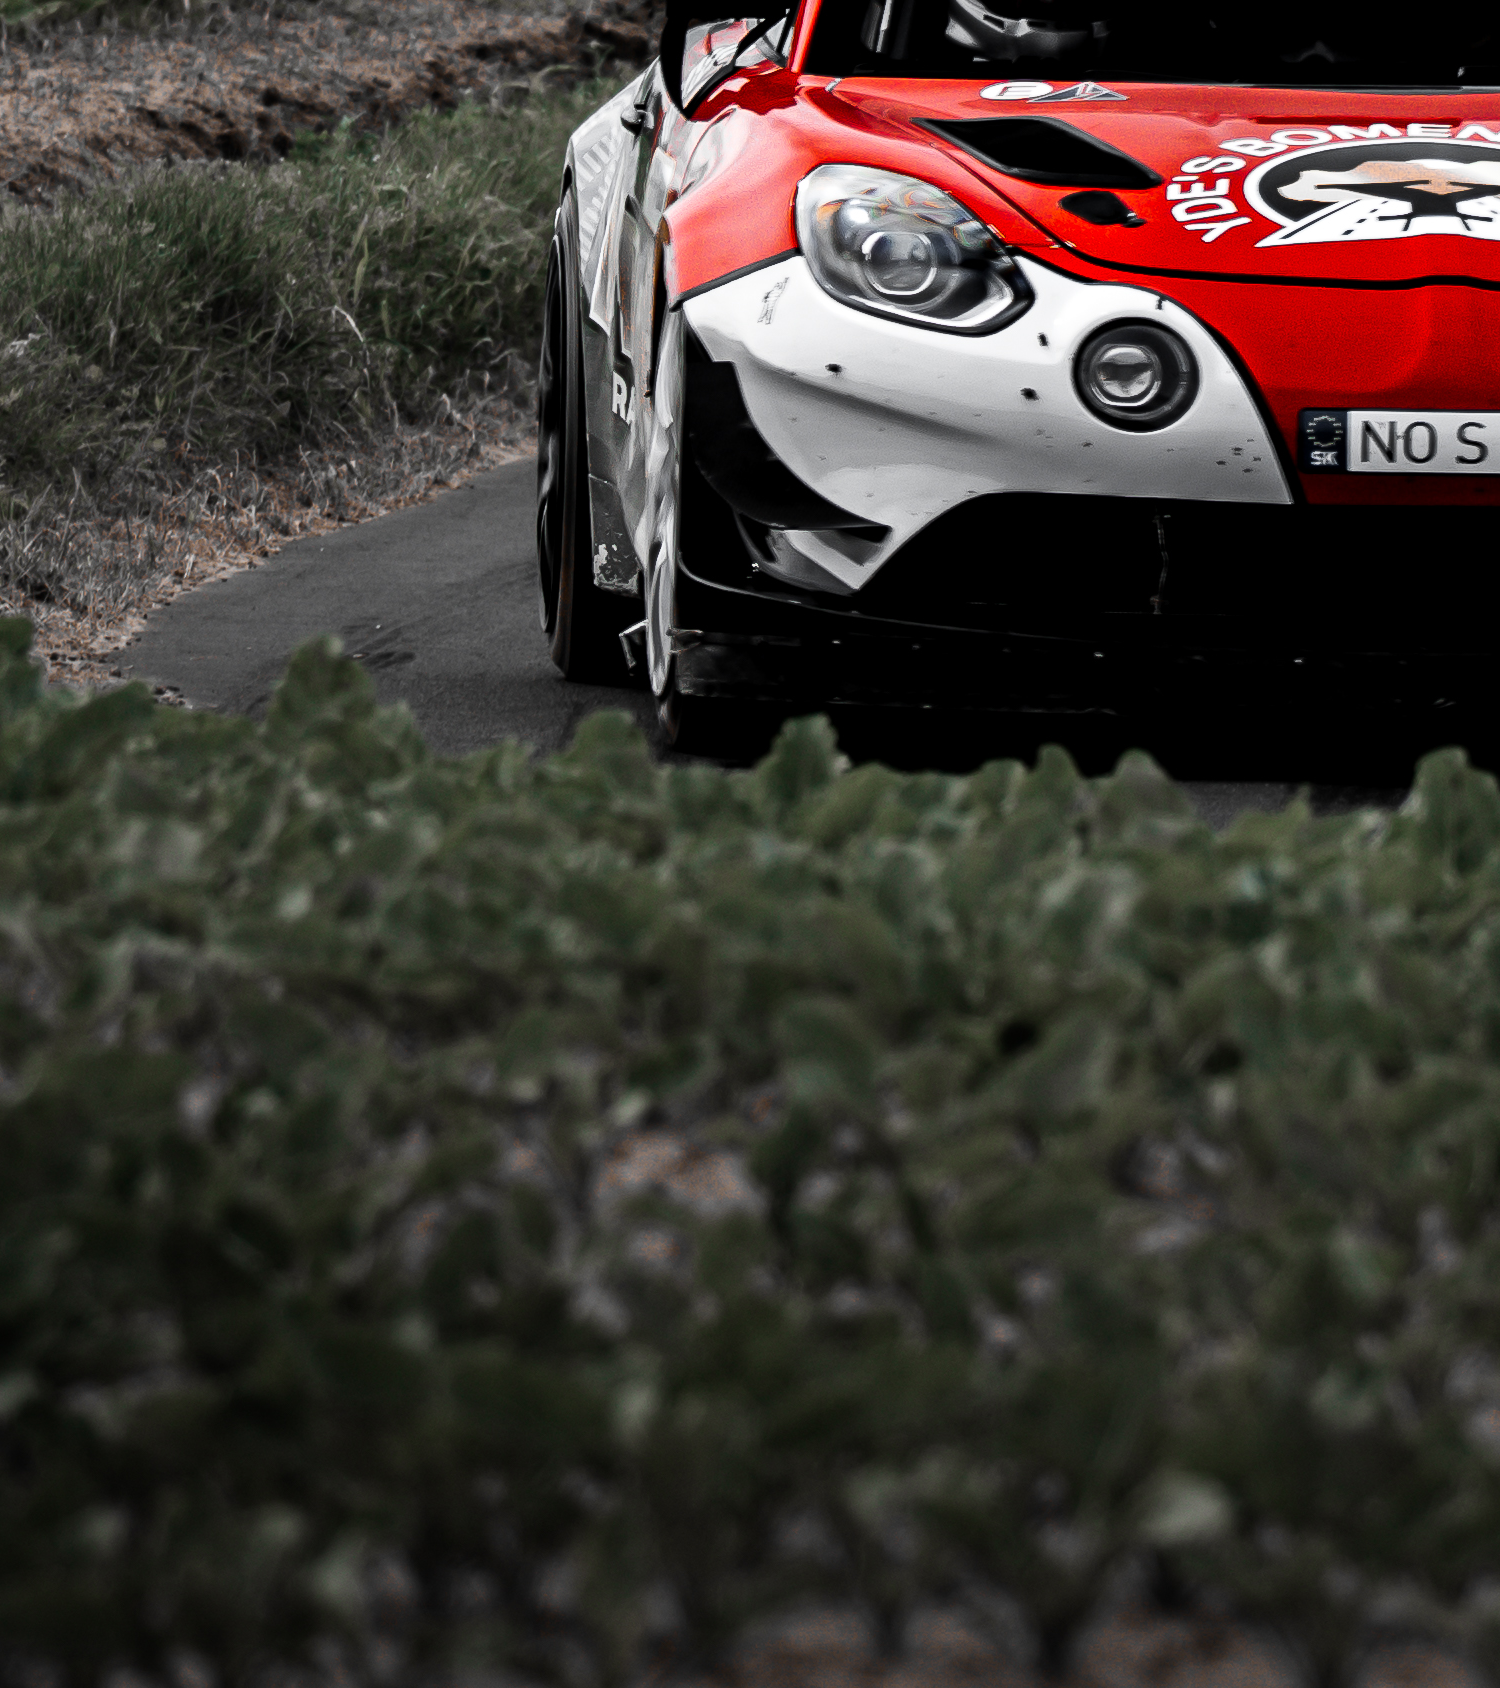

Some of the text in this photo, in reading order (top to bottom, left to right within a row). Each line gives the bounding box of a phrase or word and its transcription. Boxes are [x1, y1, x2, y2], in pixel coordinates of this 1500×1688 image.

[1166, 155, 1253, 243] YDE'S
[1359, 420, 1438, 464] NO
[1454, 421, 1489, 465] S
